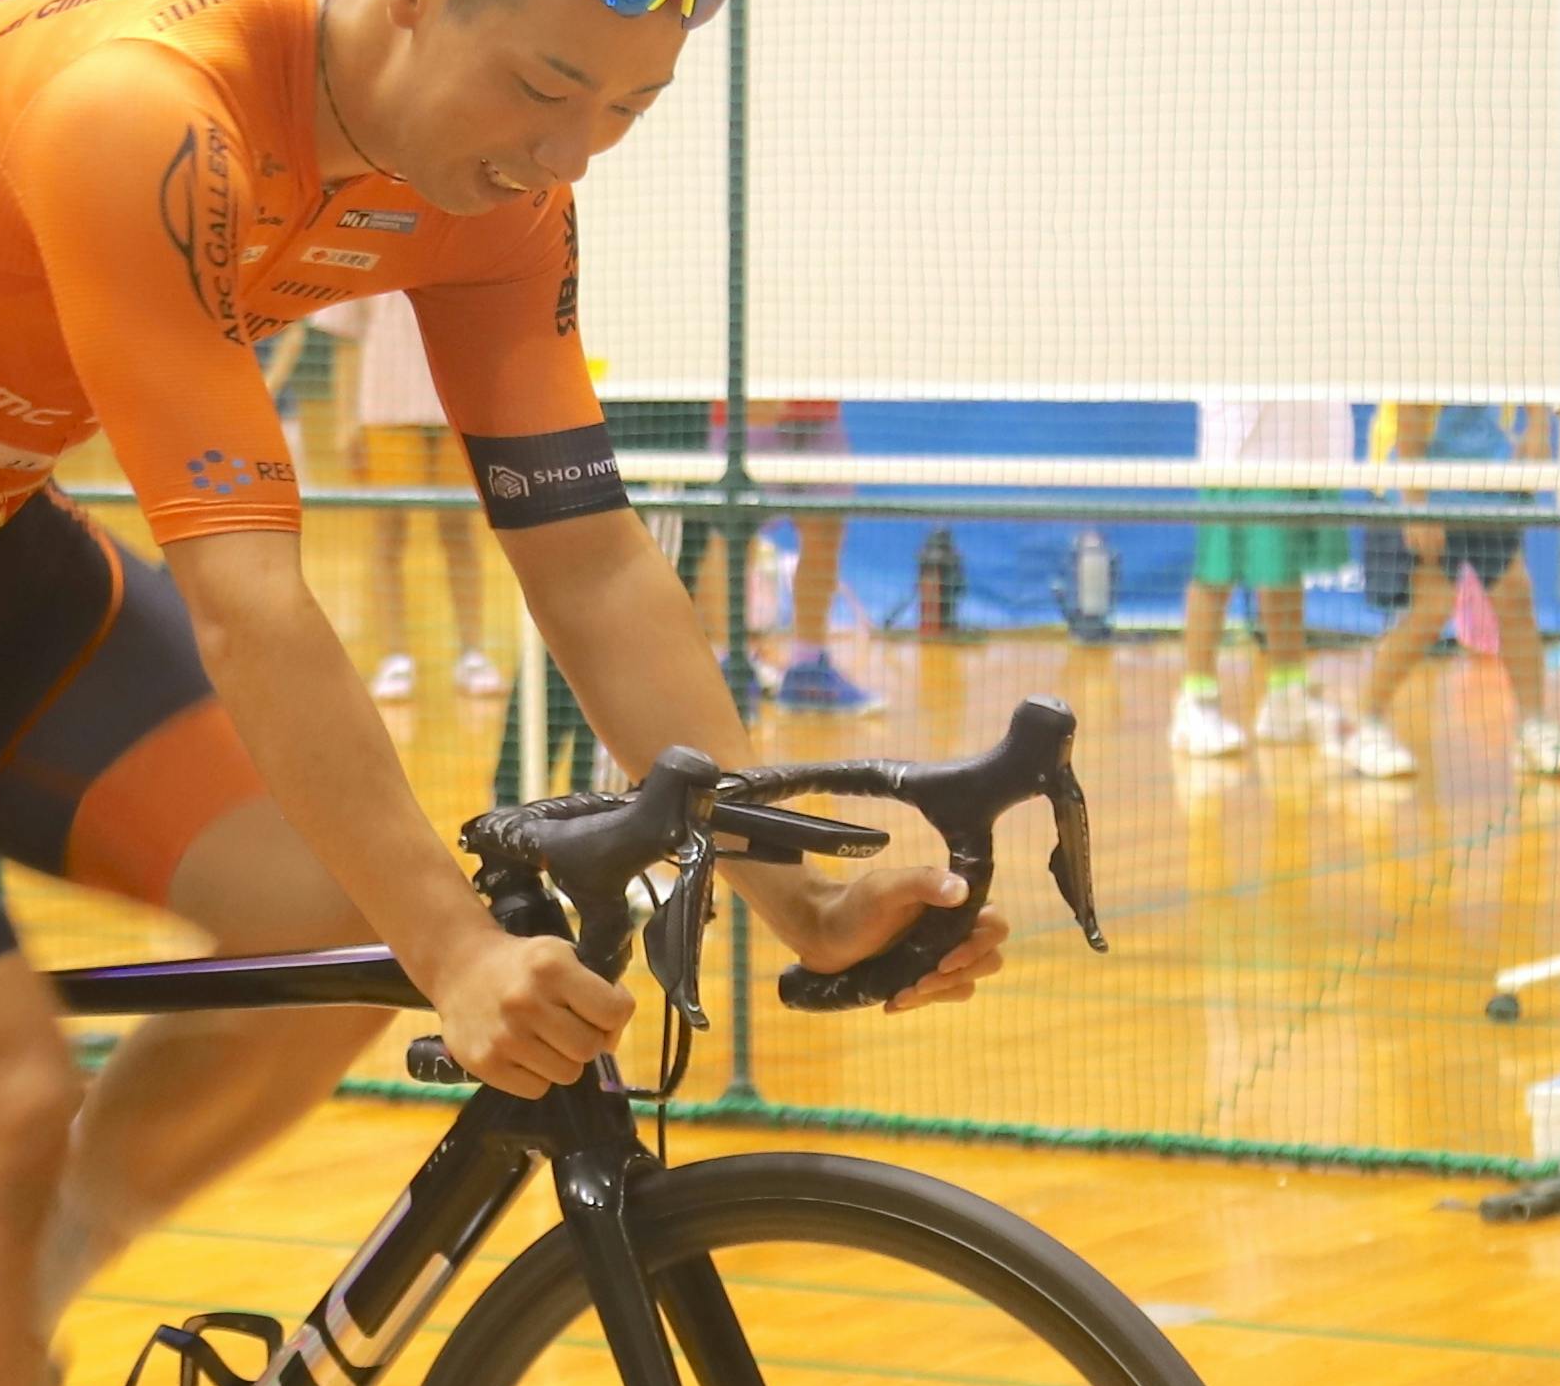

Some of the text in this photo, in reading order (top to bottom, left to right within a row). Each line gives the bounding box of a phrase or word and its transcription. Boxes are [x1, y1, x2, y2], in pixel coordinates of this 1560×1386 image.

[255, 461, 296, 483] RES
[533, 458, 619, 485] SHO INTE
